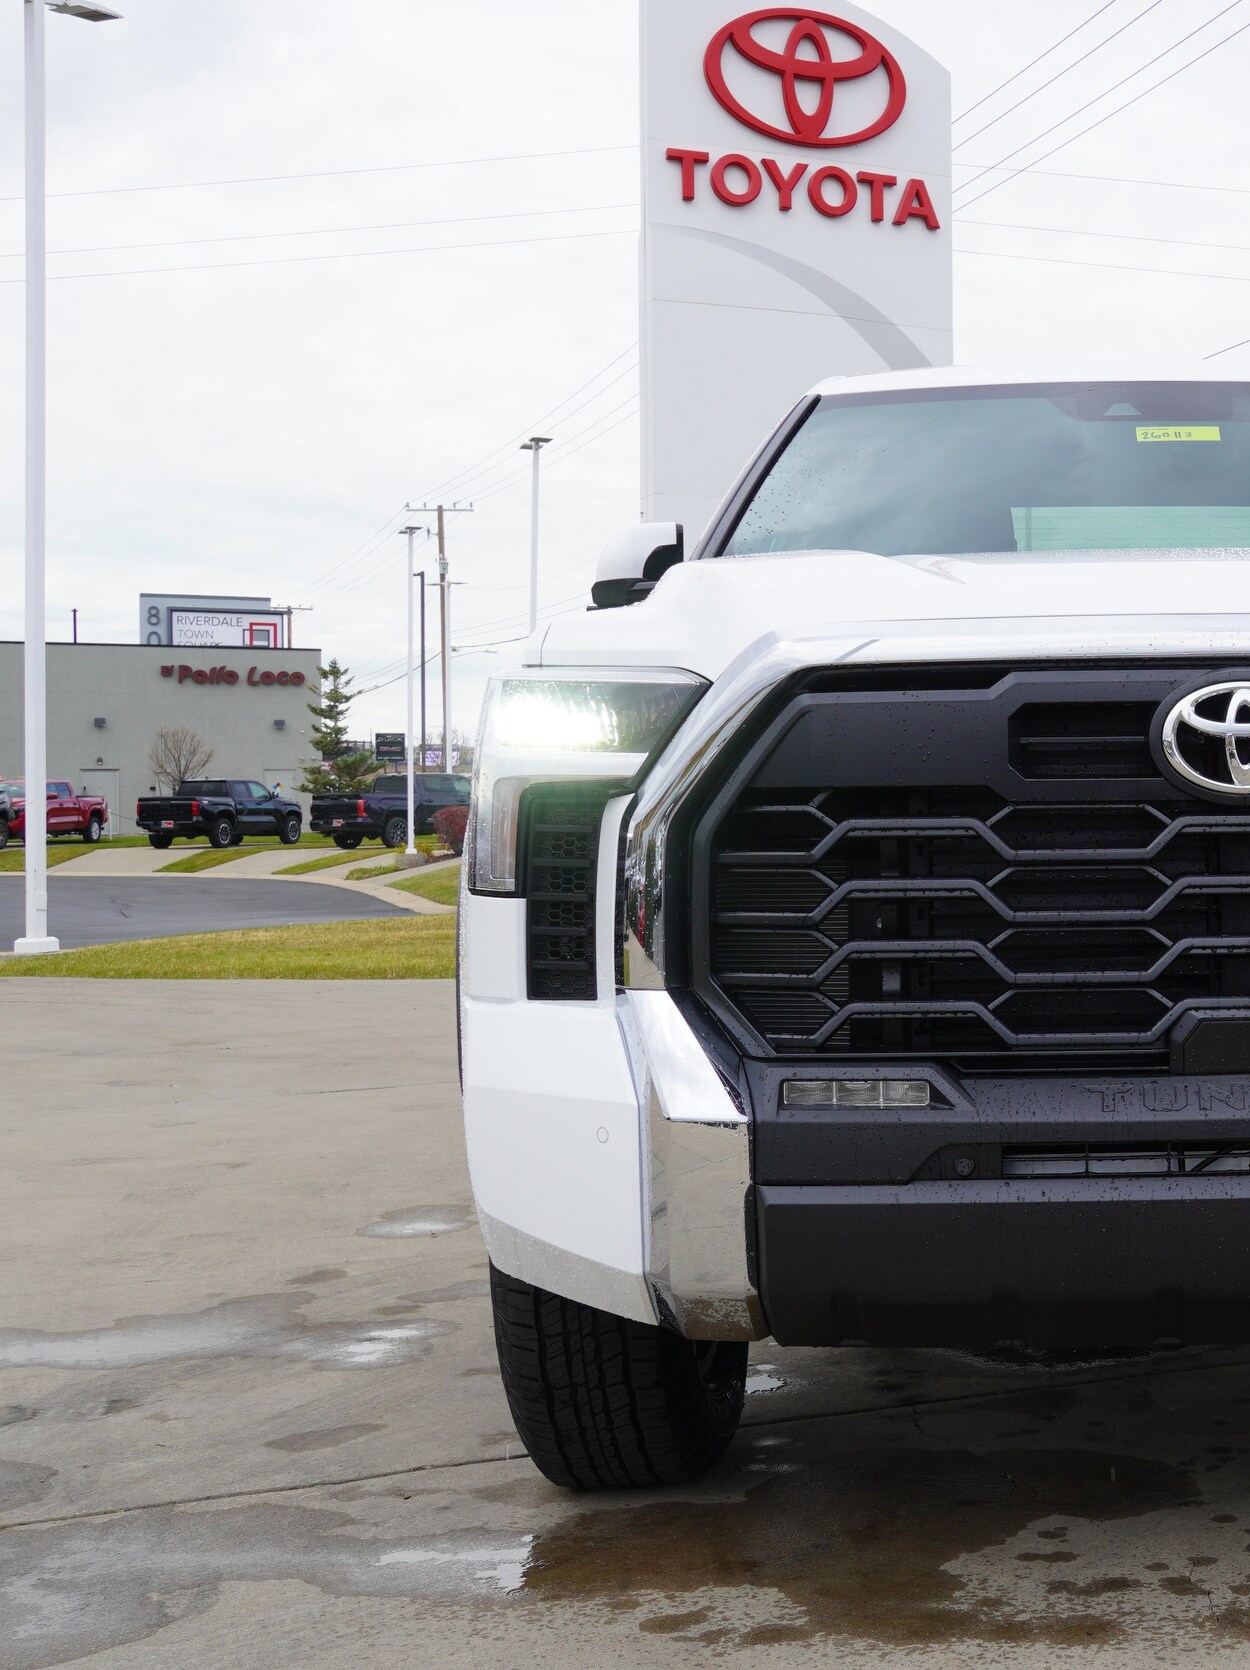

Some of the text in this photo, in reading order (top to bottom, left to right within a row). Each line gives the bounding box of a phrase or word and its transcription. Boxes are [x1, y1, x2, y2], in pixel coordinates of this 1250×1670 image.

[666, 147, 941, 230] TOYOTA
[176, 615, 244, 627] RIVERDALE
[177, 629, 214, 639] TOWN
[177, 664, 240, 685] Pollo
[246, 666, 306, 687] Loco
